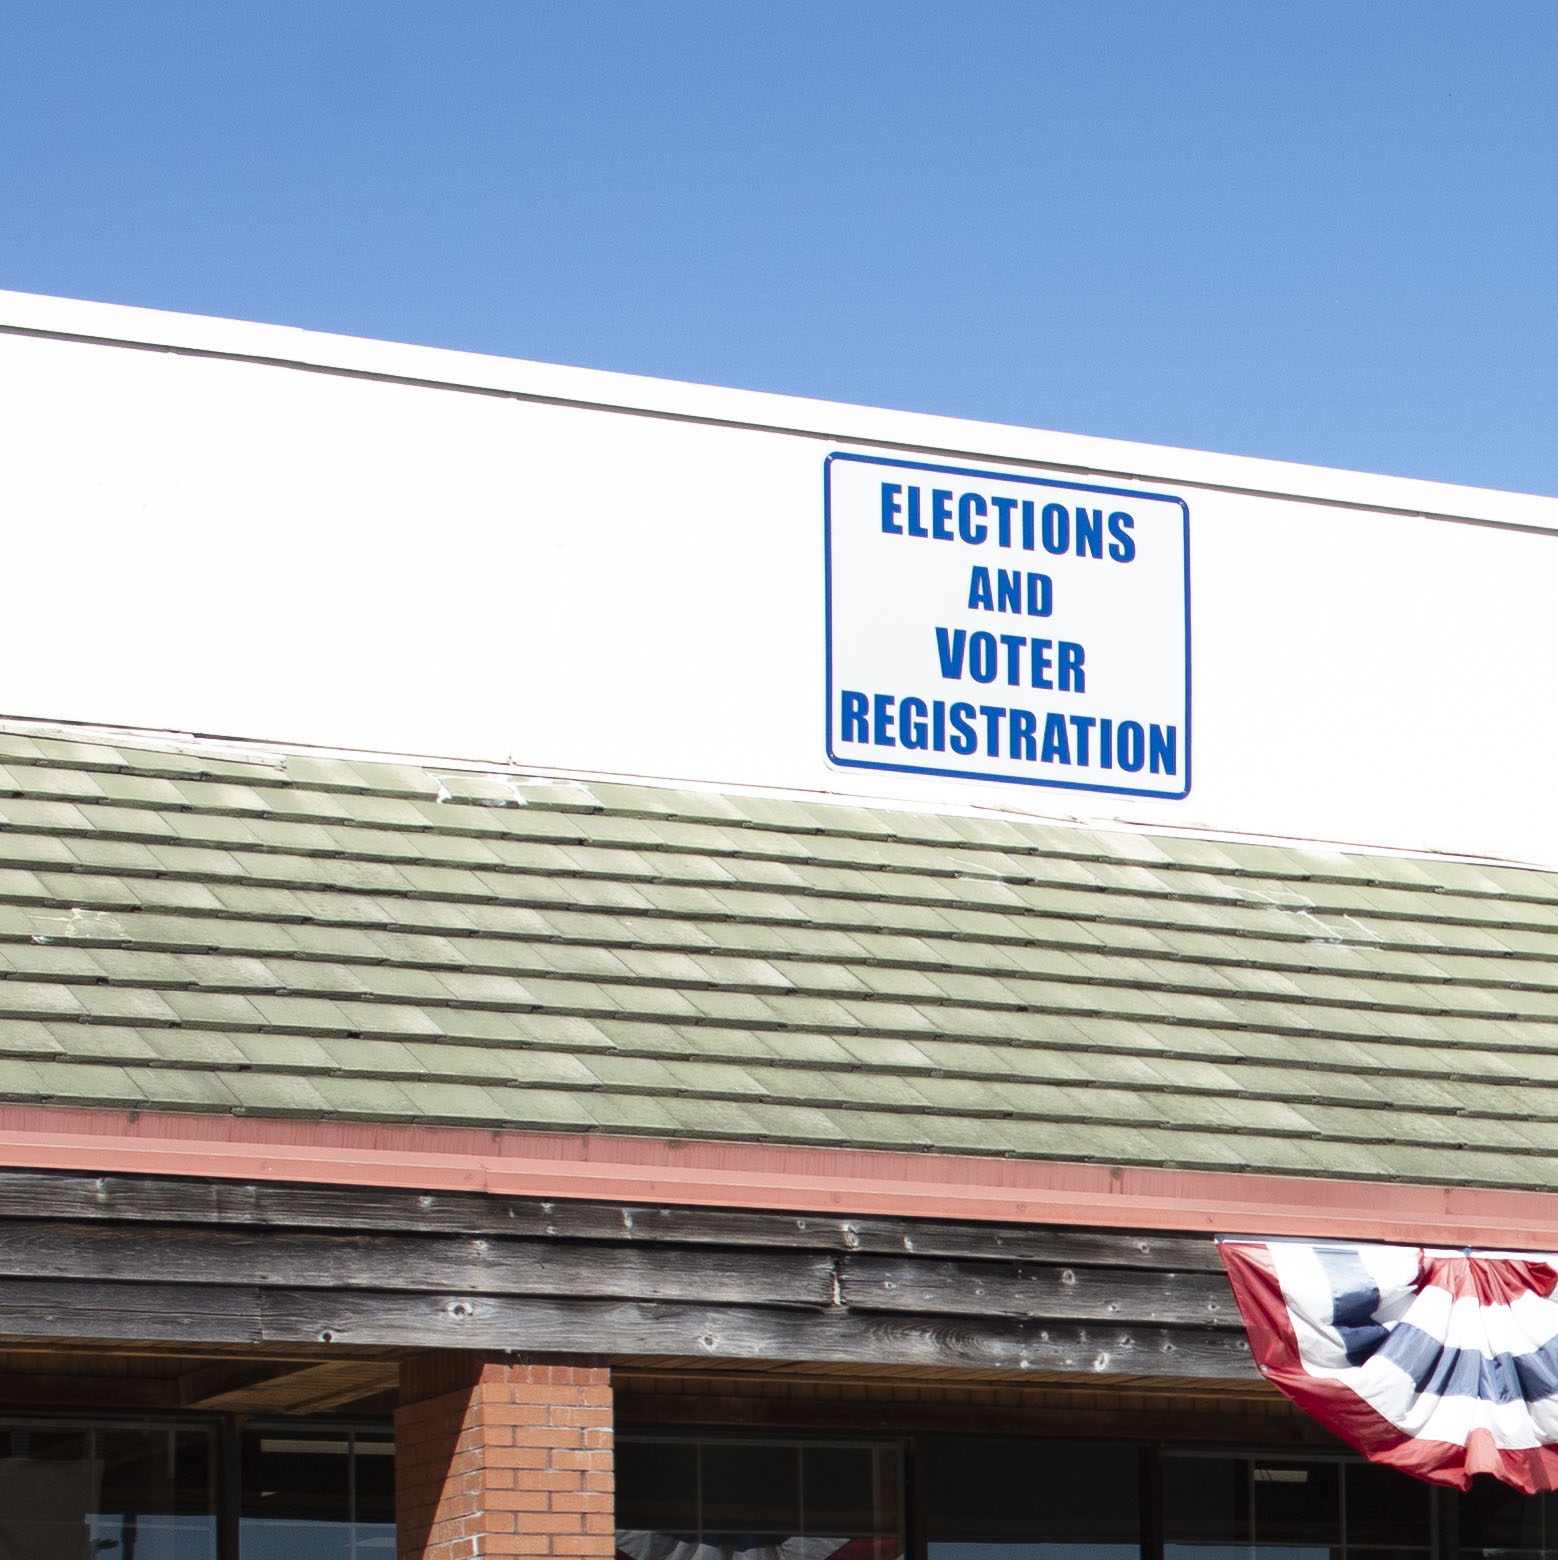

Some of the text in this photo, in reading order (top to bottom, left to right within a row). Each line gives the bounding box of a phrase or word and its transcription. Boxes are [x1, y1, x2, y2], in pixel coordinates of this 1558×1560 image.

[881, 481, 1136, 564] ELECTIONS
[968, 565, 1053, 618] AND
[935, 626, 1086, 693] VOTER
[841, 689, 1177, 776] REGISTRATION
